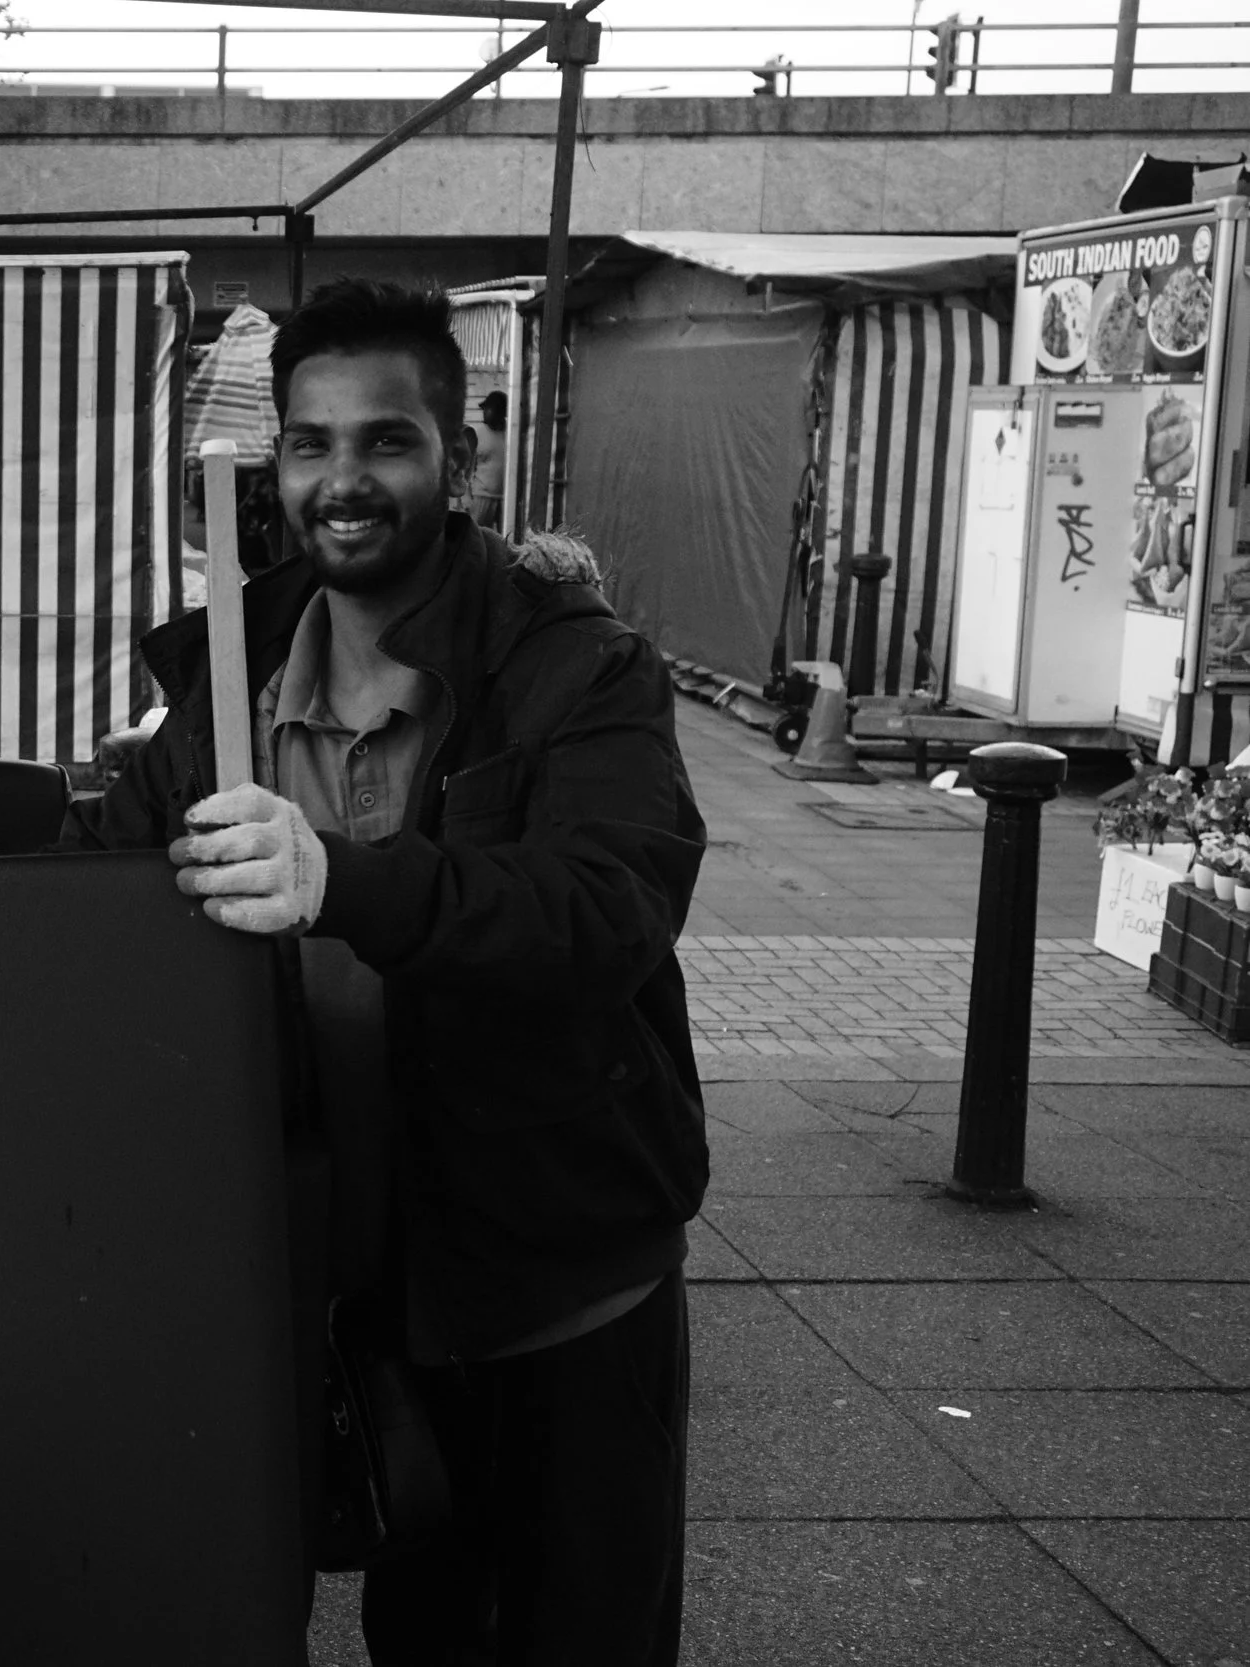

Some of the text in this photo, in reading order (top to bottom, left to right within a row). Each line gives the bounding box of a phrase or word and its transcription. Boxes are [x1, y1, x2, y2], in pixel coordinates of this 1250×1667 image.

[1028, 233, 1180, 281] SOUTH INDIAN FOOD
